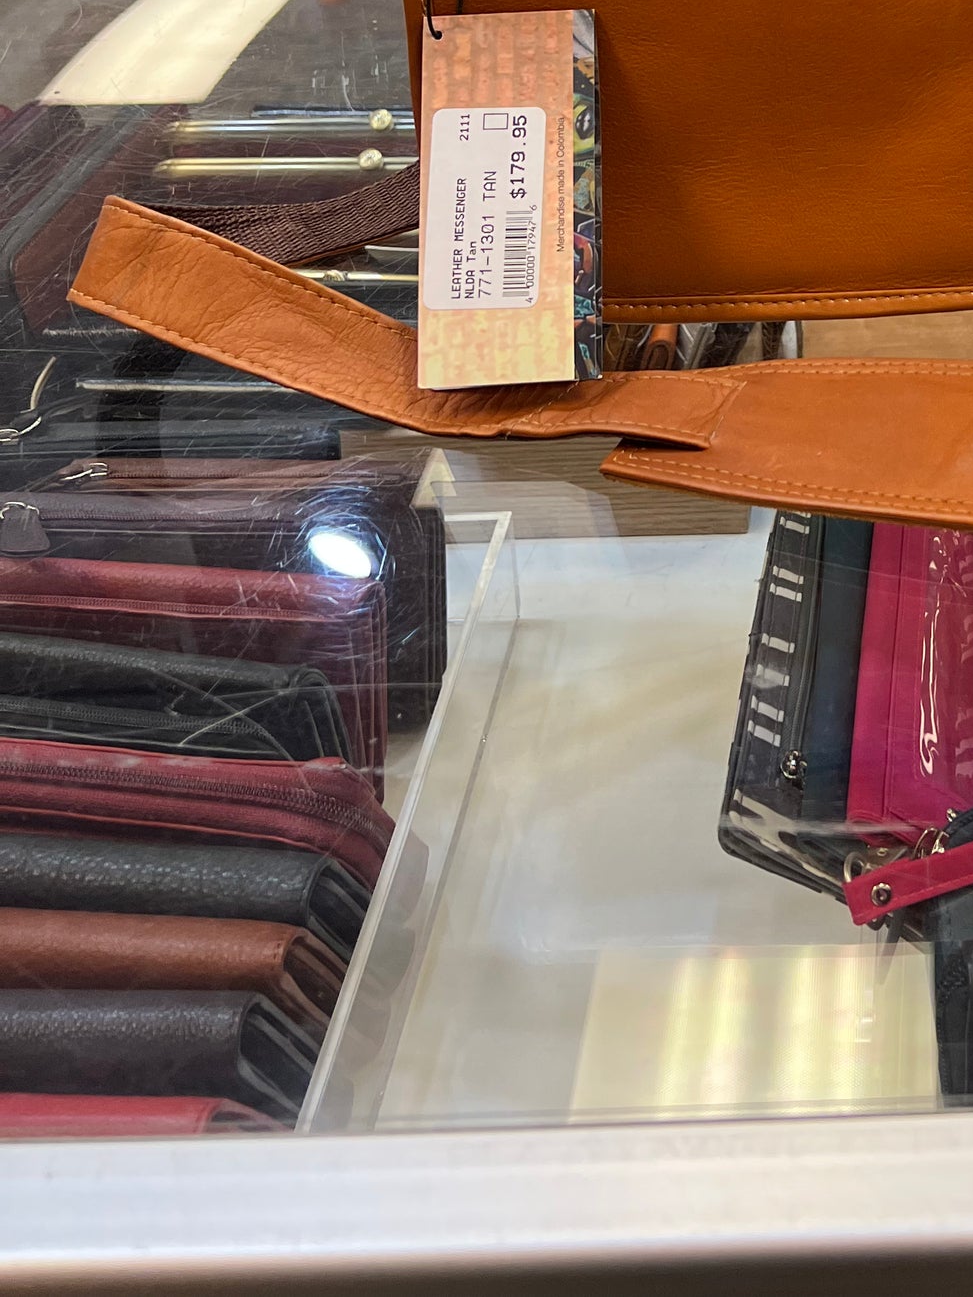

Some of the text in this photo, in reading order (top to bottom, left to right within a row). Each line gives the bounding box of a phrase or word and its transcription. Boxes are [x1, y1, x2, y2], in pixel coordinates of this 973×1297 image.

[459, 114, 470, 141] 2111
[556, 117, 565, 158] Colombia
[509, 115, 527, 199] $179.95
[557, 170, 565, 194] made
[451, 178, 466, 299] LEATHER MESSENGER
[478, 171, 496, 298] 771-1301 TAN
[556, 196, 565, 252] Merchandise
[465, 241, 476, 299] NLDA Tan
